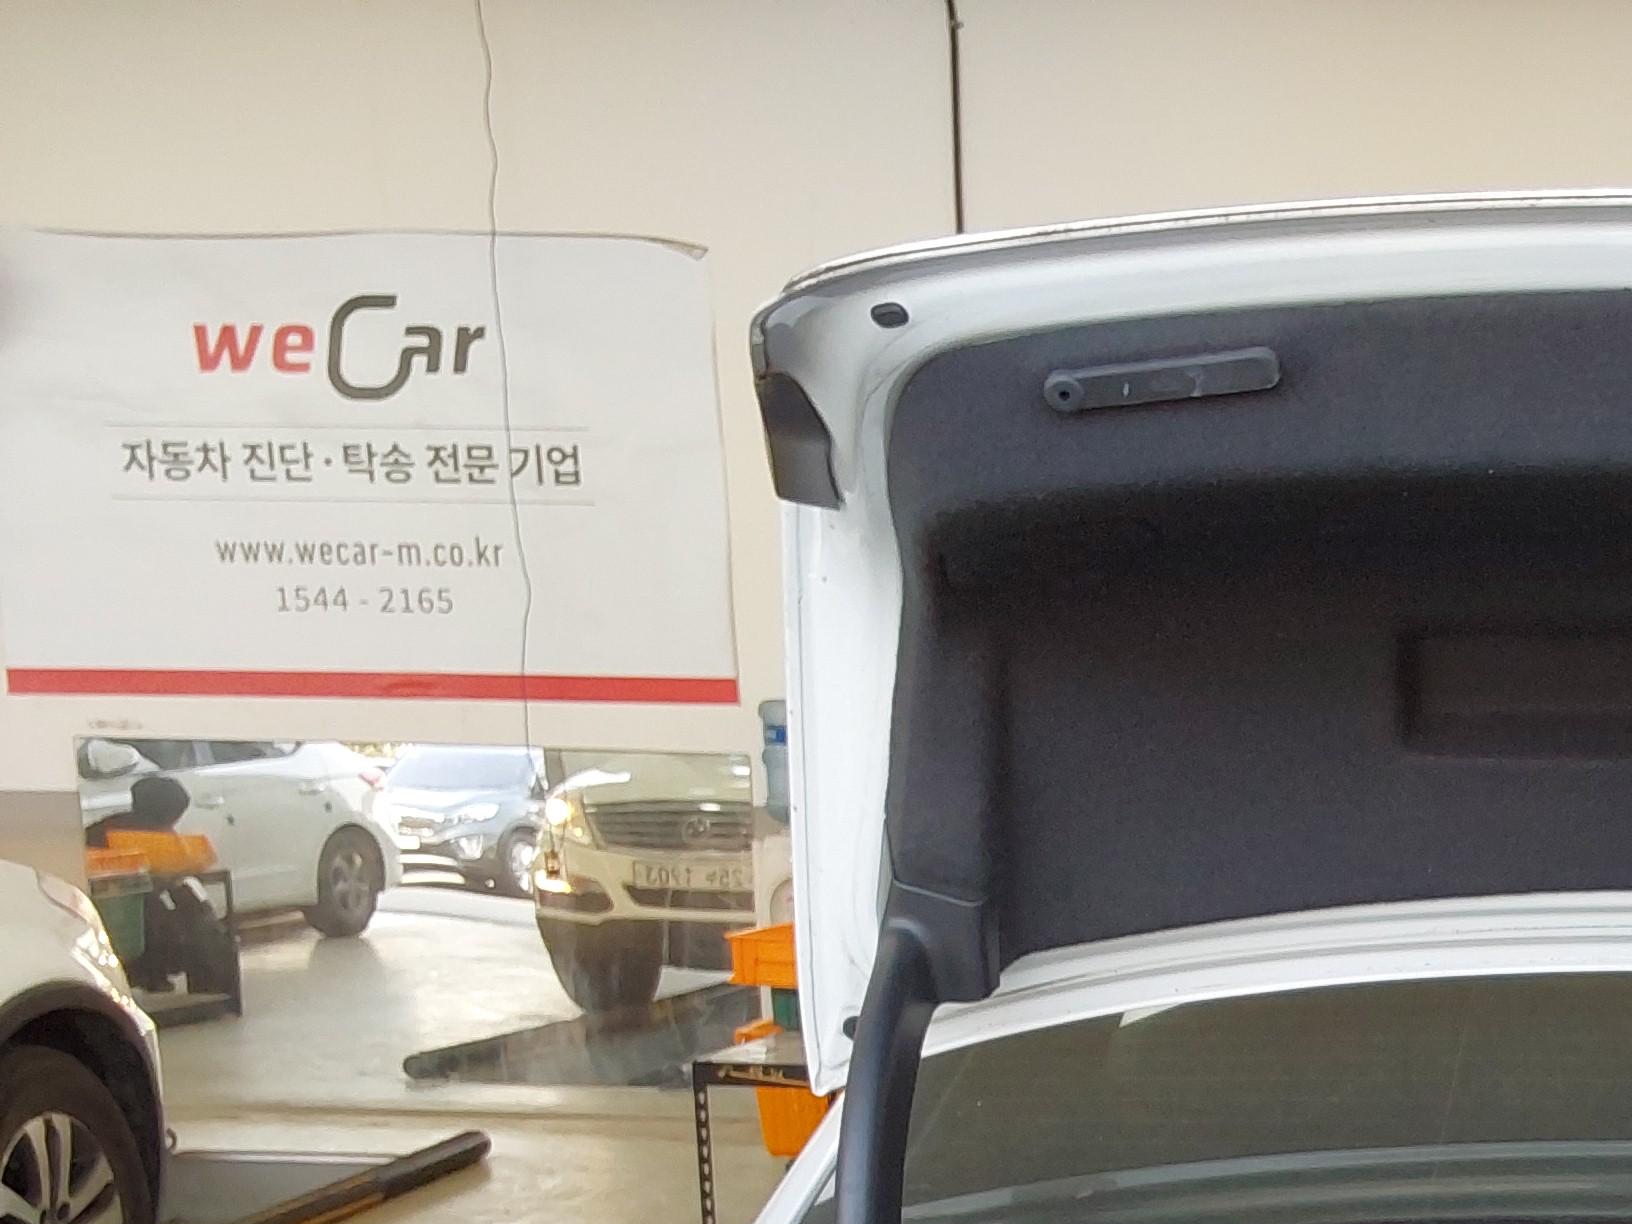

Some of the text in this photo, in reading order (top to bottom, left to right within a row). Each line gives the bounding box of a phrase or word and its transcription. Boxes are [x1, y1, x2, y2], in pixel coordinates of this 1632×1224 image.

[122, 439, 231, 482] 자동차
[426, 443, 499, 485] 전문
[511, 444, 582, 487] 기업
[216, 536, 502, 567] www.wecar-m.co.kr
